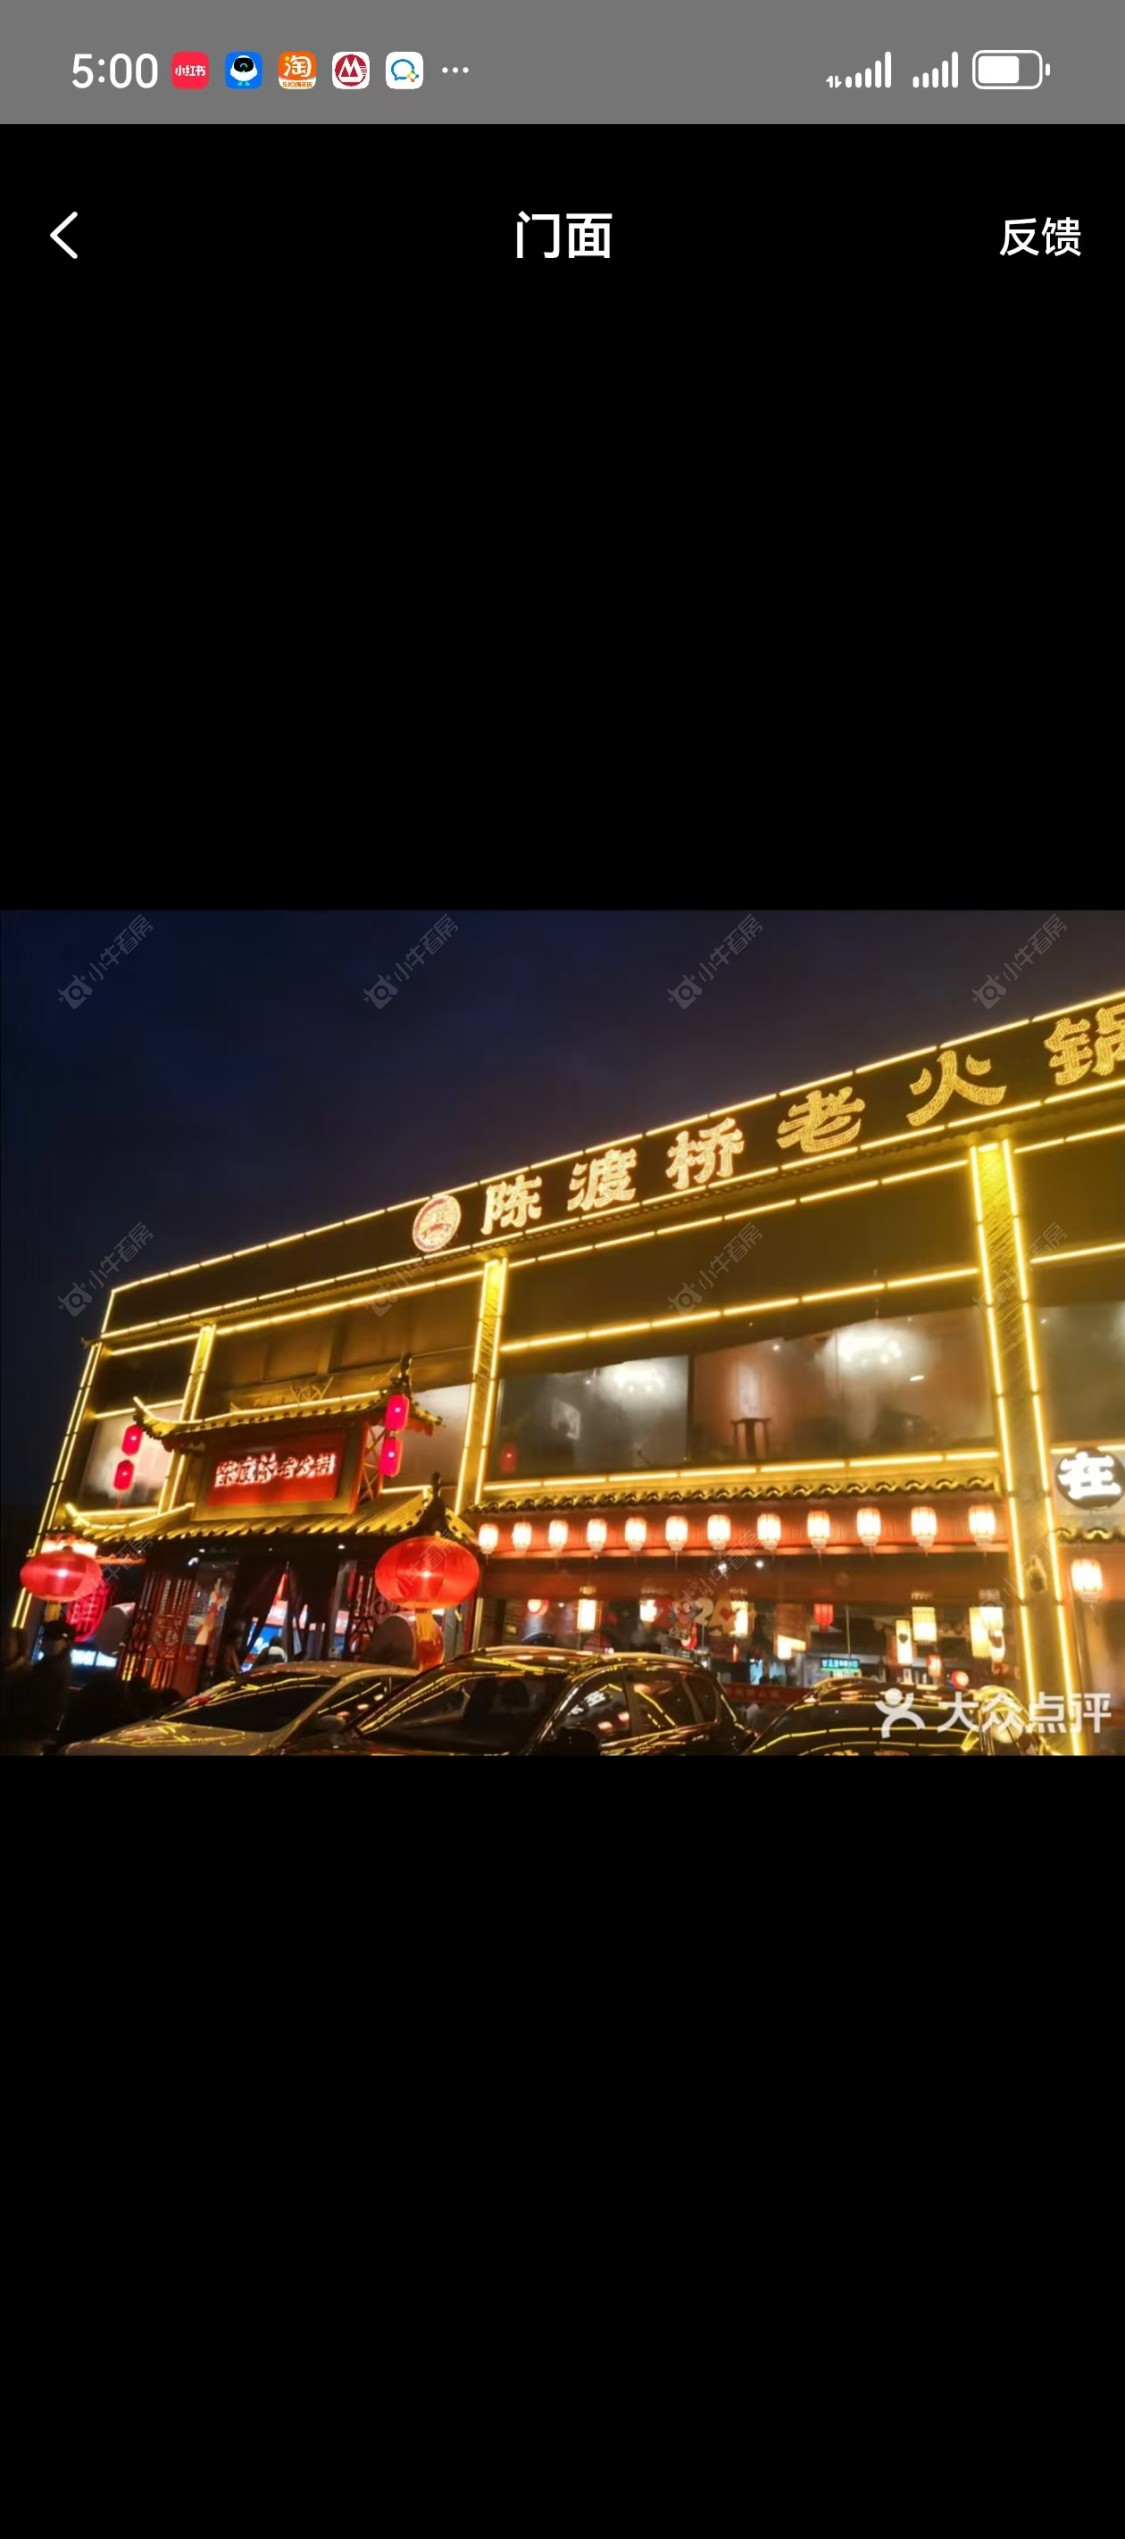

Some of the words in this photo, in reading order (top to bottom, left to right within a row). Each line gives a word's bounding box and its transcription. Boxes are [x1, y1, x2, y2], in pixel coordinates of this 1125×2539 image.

[480, 1002, 1125, 1235] 陈渡桥老火锅
[1057, 1451, 1122, 1500] 在
